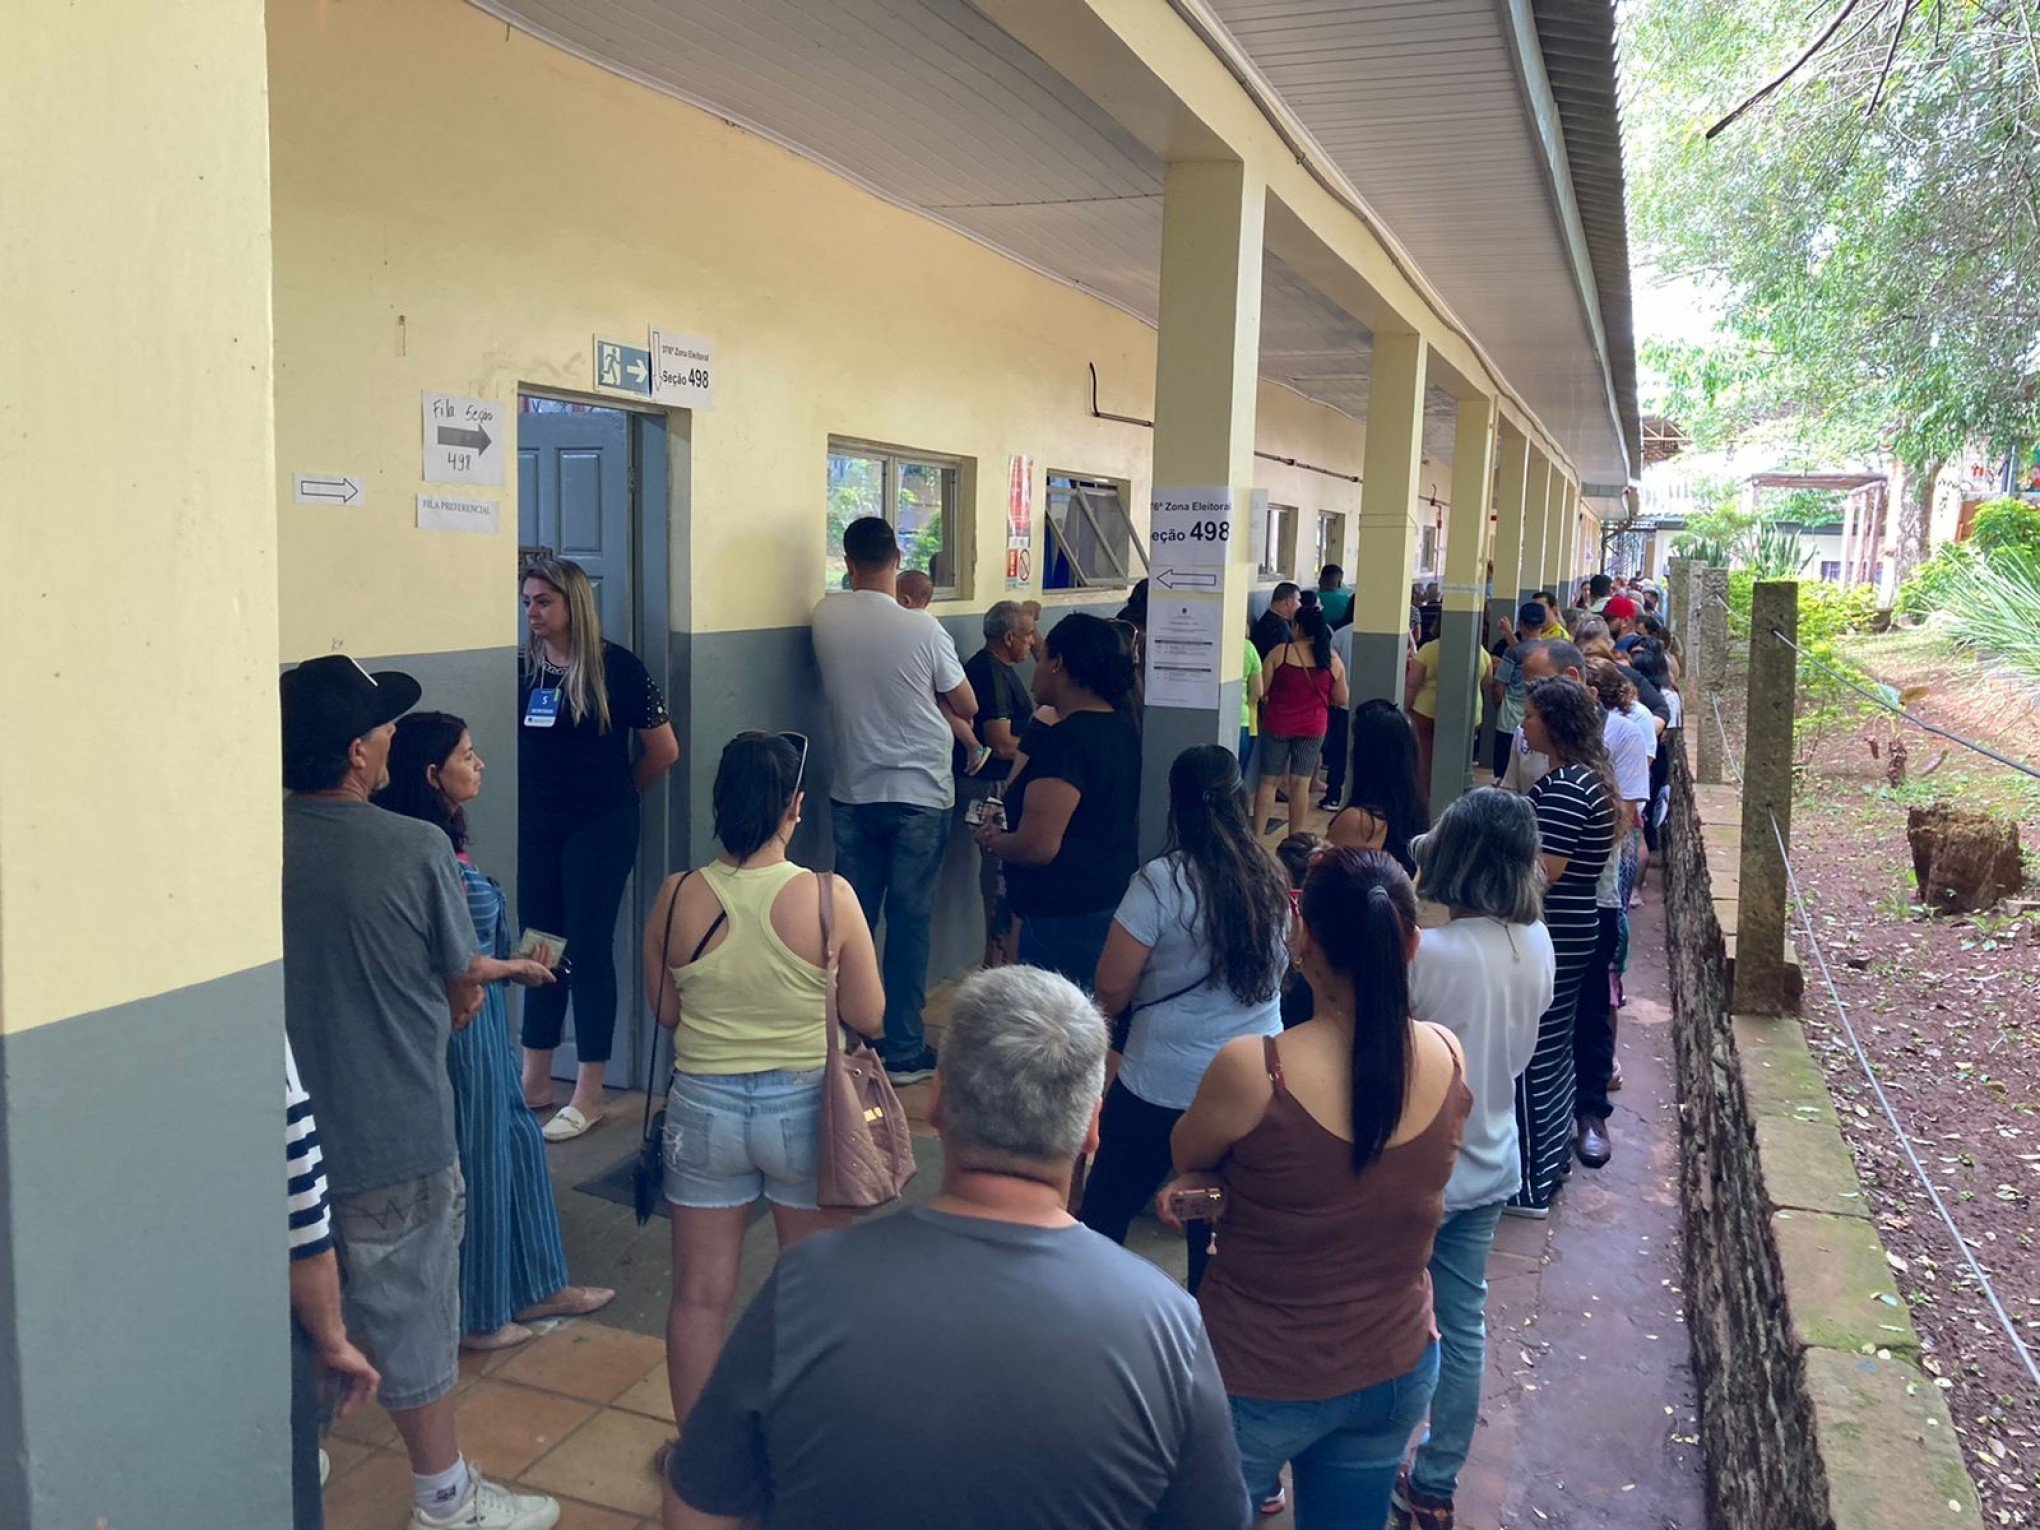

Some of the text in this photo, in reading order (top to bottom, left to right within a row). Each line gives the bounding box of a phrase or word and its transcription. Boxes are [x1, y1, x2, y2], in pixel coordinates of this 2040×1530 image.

[675, 347, 687, 357] Zona
[662, 368, 709, 389] Seção 498
[433, 399, 455, 418] Fila
[447, 452, 471, 471] 498
[422, 499, 490, 515] FILA PREFERENCIAL
[1165, 502, 1189, 511] Zona
[1190, 521, 1230, 541] 498
